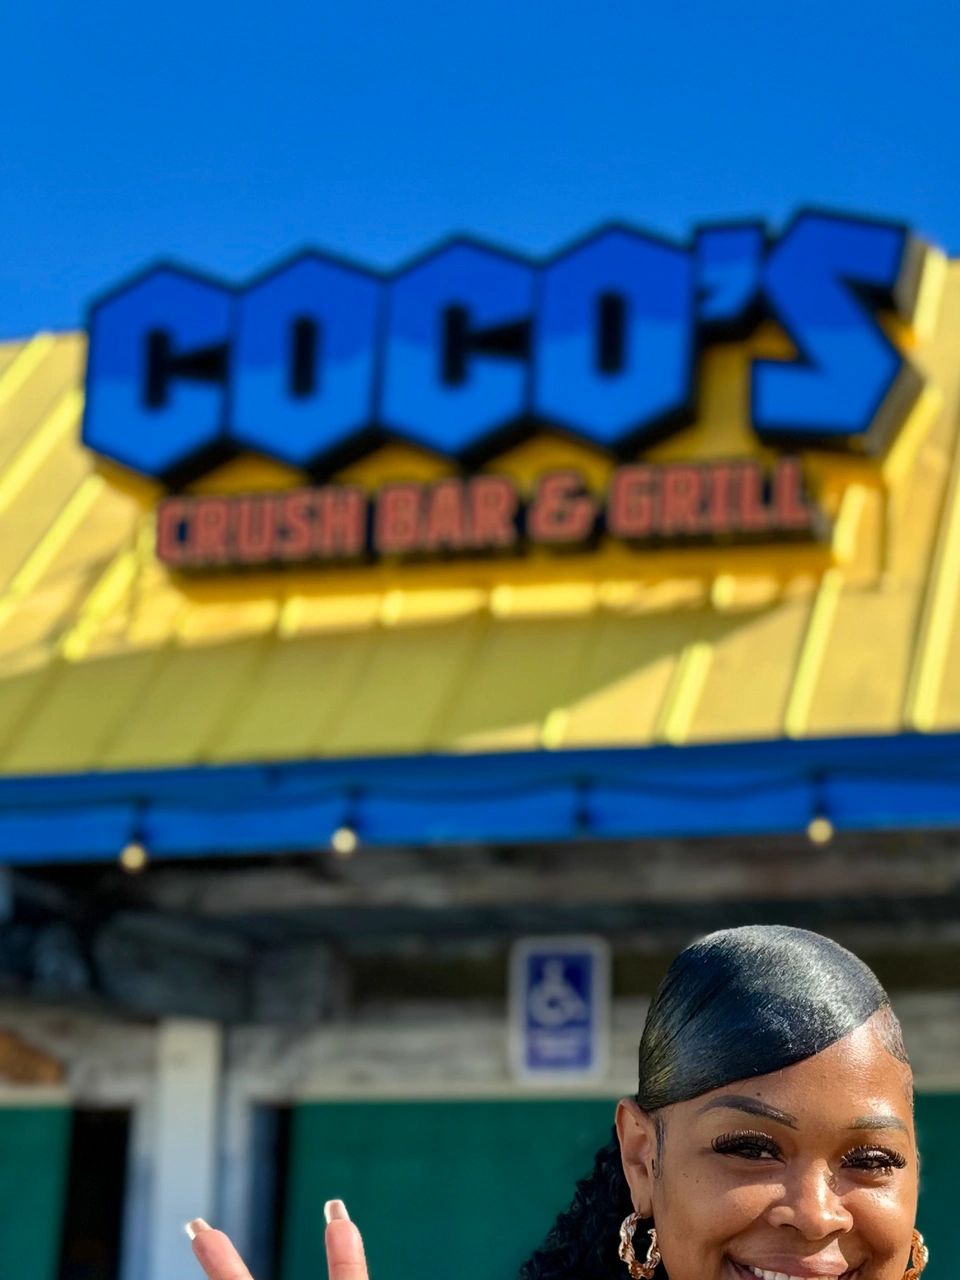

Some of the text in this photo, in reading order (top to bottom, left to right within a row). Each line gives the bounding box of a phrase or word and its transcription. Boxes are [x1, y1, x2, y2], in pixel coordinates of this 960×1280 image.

[82, 206, 912, 478] COCO'S
[155, 455, 812, 565] CRUSH BAR & GRILL
